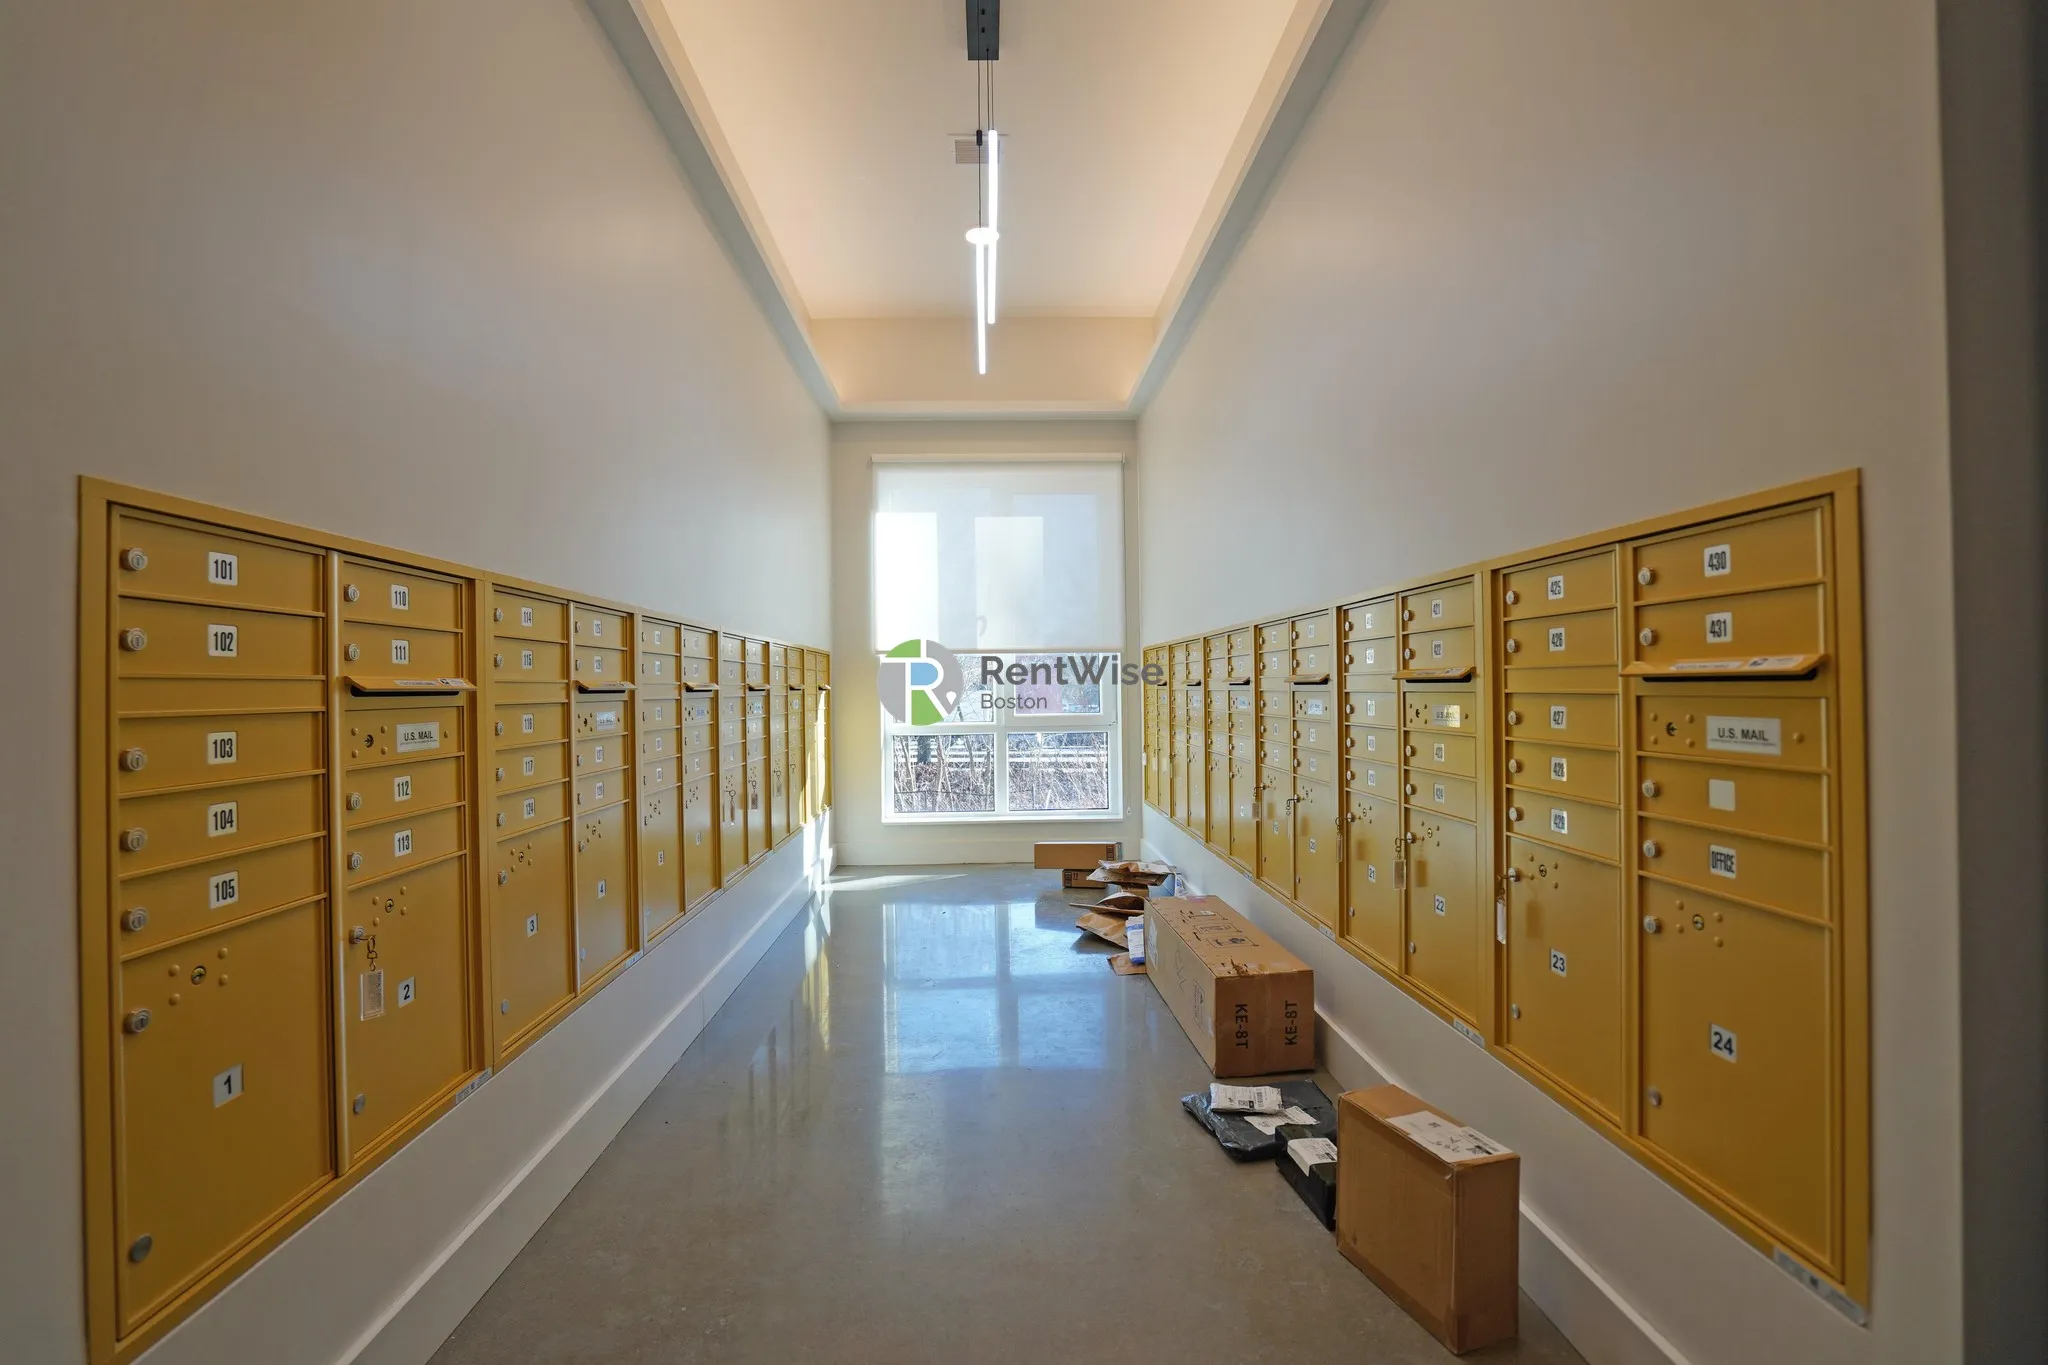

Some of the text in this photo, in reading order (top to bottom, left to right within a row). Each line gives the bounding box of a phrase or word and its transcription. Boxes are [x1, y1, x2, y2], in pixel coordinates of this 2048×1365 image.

[214, 559, 232, 580] 101
[1708, 551, 1727, 572] 430
[1550, 580, 1561, 596] 425
[394, 590, 406, 606] 110
[524, 611, 532, 624] 114
[1710, 620, 1727, 638] 431
[214, 632, 234, 652] 102
[394, 645, 407, 660] 111
[524, 654, 532, 666] 115
[1553, 710, 1564, 725] 427
[404, 731, 434, 742] U.S. MAIL
[1718, 728, 1768, 742] U.S. MAIL
[213, 738, 233, 758] 103
[525, 760, 533, 773] 117
[396, 781, 410, 797] 112
[213, 809, 234, 830] 104
[397, 835, 412, 852] 113
[1711, 852, 1736, 874] OFFICE
[214, 878, 235, 902] 105
[1435, 899, 1444, 912] 22
[1552, 954, 1565, 972] 23
[404, 984, 410, 1000] 2
[1234, 1004, 1248, 1048] KE-8T
[1284, 1000, 1298, 1046] KE-8T
[1714, 1031, 1734, 1055] 24
[224, 1075, 232, 1094] 1
